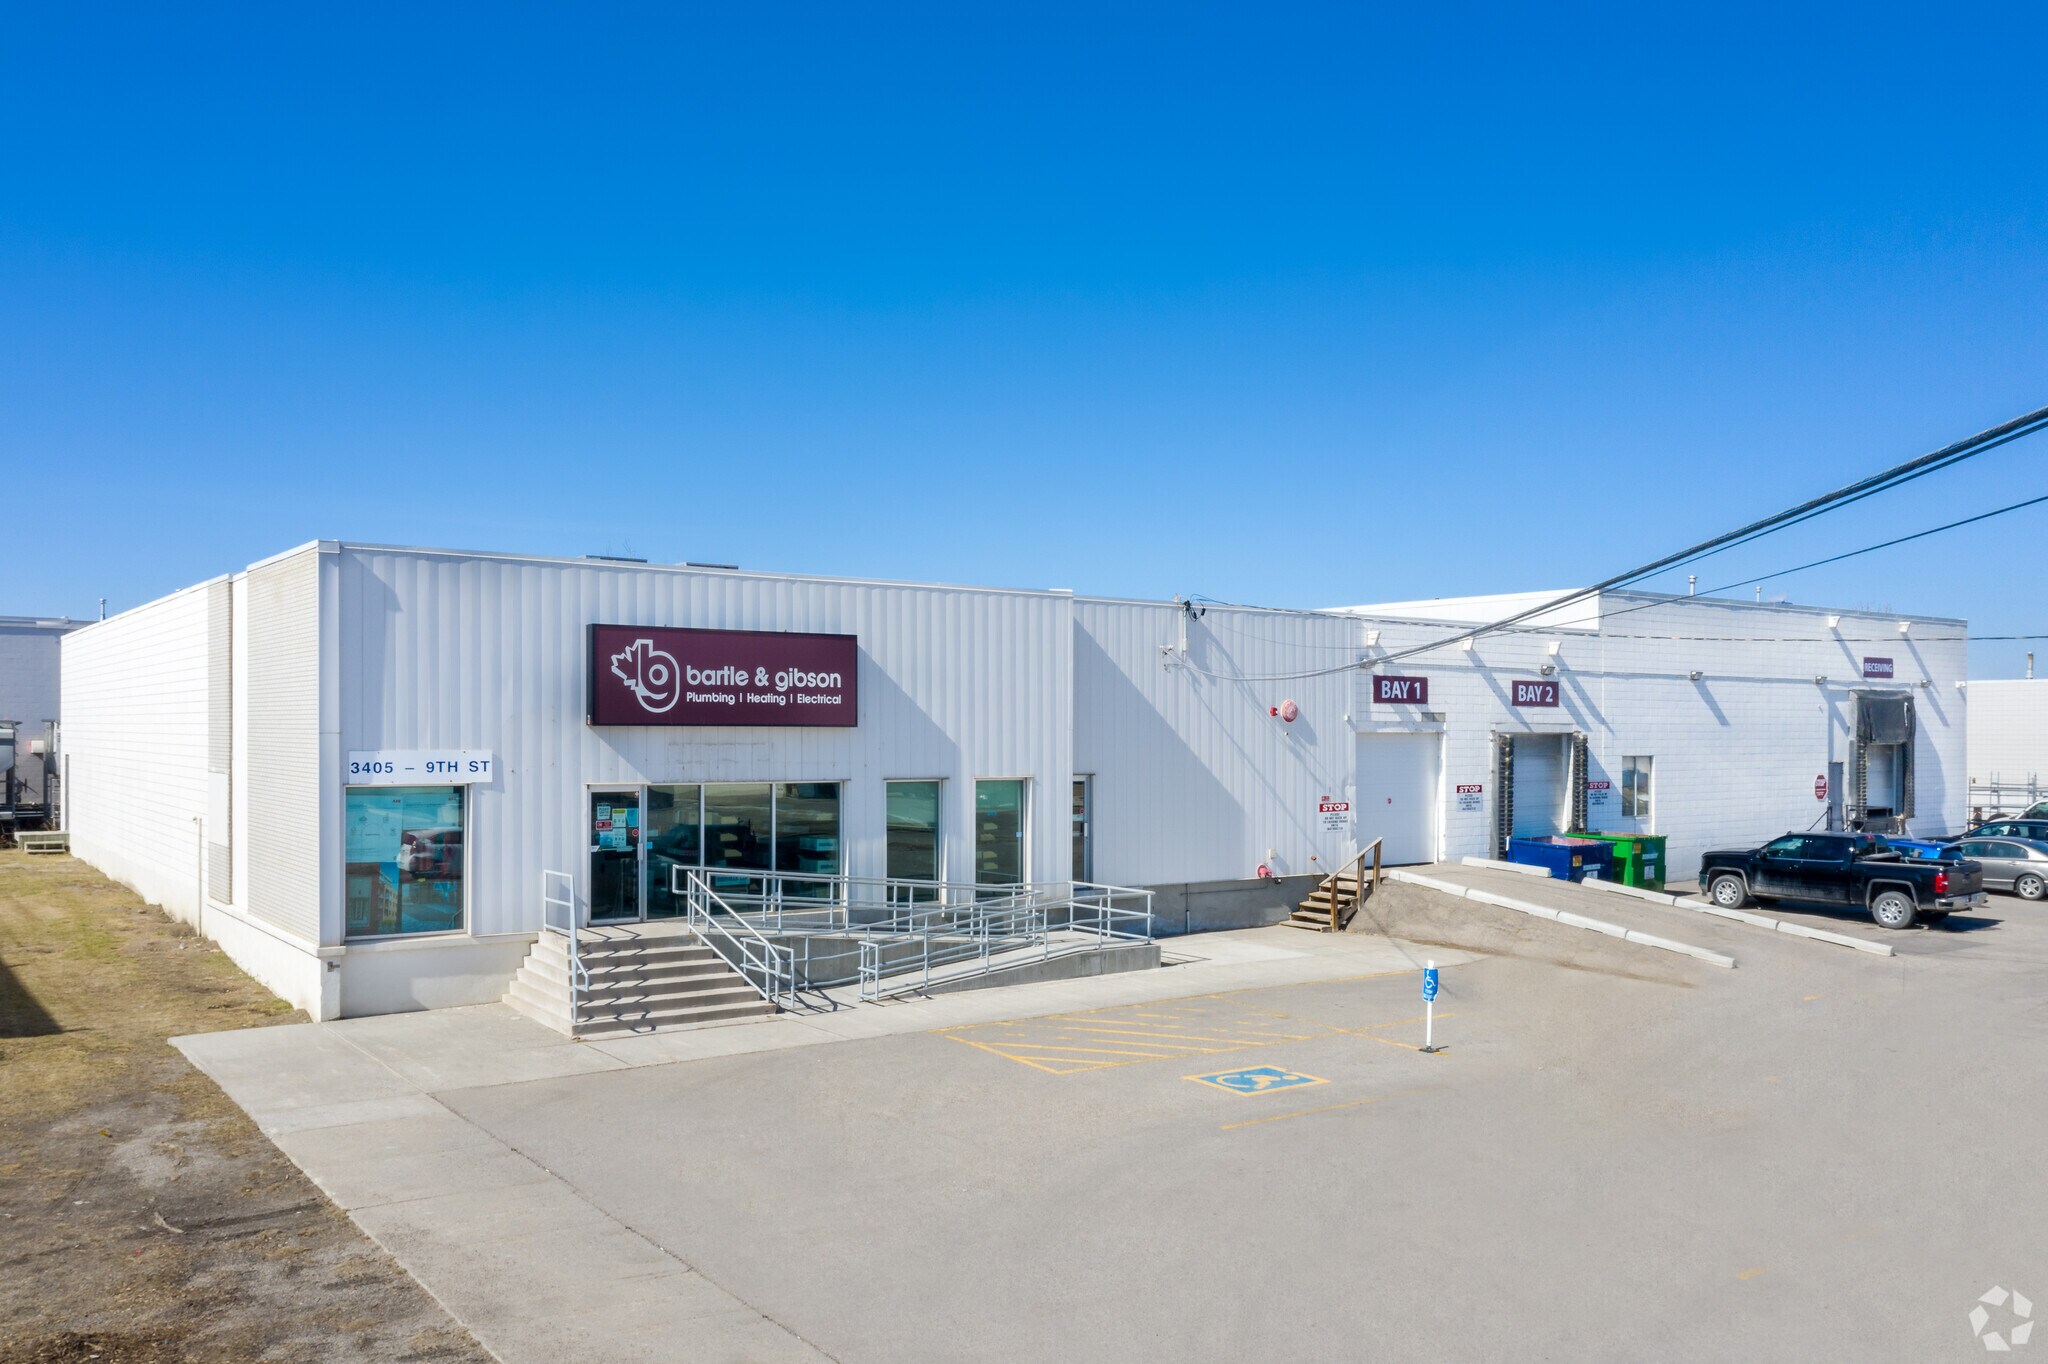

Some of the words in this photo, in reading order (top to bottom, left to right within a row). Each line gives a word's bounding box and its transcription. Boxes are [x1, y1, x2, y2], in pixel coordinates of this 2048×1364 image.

[1864, 662, 1893, 673] RECEIVING
[686, 665, 749, 686] bartle
[754, 667, 769, 687] &
[775, 668, 842, 692] gibson
[1381, 681, 1411, 699] BAY
[1413, 682, 1421, 699] 1
[1518, 684, 1543, 702] BAY
[1545, 686, 1553, 702] 2
[686, 692, 735, 705] Plumbing
[747, 693, 786, 706] Heating
[797, 694, 842, 705] Electrical
[350, 762, 394, 774] 3405
[426, 761, 458, 773] 9TH
[468, 760, 490, 773] ST
[1459, 785, 1481, 793] STOP
[1322, 803, 1348, 812] STOP
